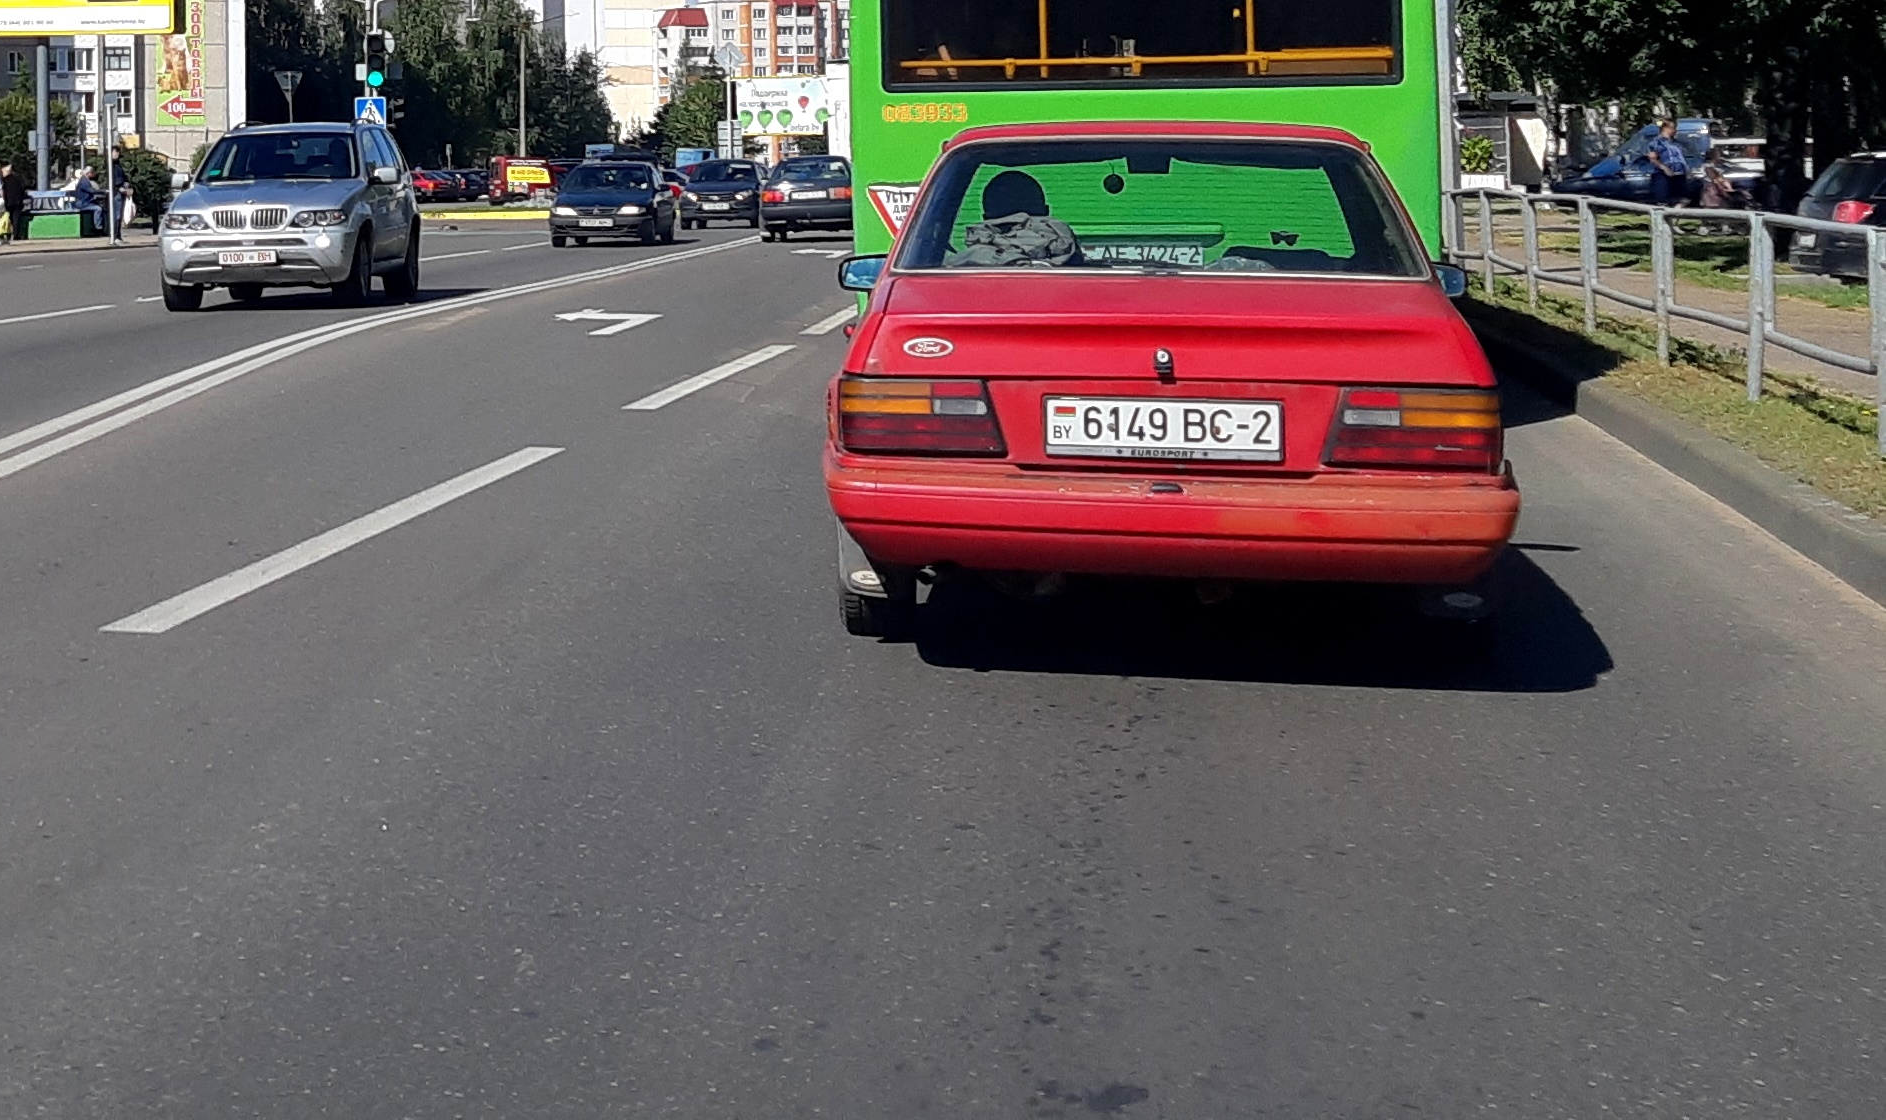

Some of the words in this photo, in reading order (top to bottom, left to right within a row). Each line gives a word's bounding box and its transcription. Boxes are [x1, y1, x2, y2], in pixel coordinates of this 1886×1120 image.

[167, 102, 186, 113] 100
[223, 253, 244, 262] 0100
[1053, 425, 1072, 439] BY
[1083, 406, 1167, 441] 6149
[1183, 408, 1272, 445] BC-2
[1131, 449, 1195, 458] EUROSPORT
